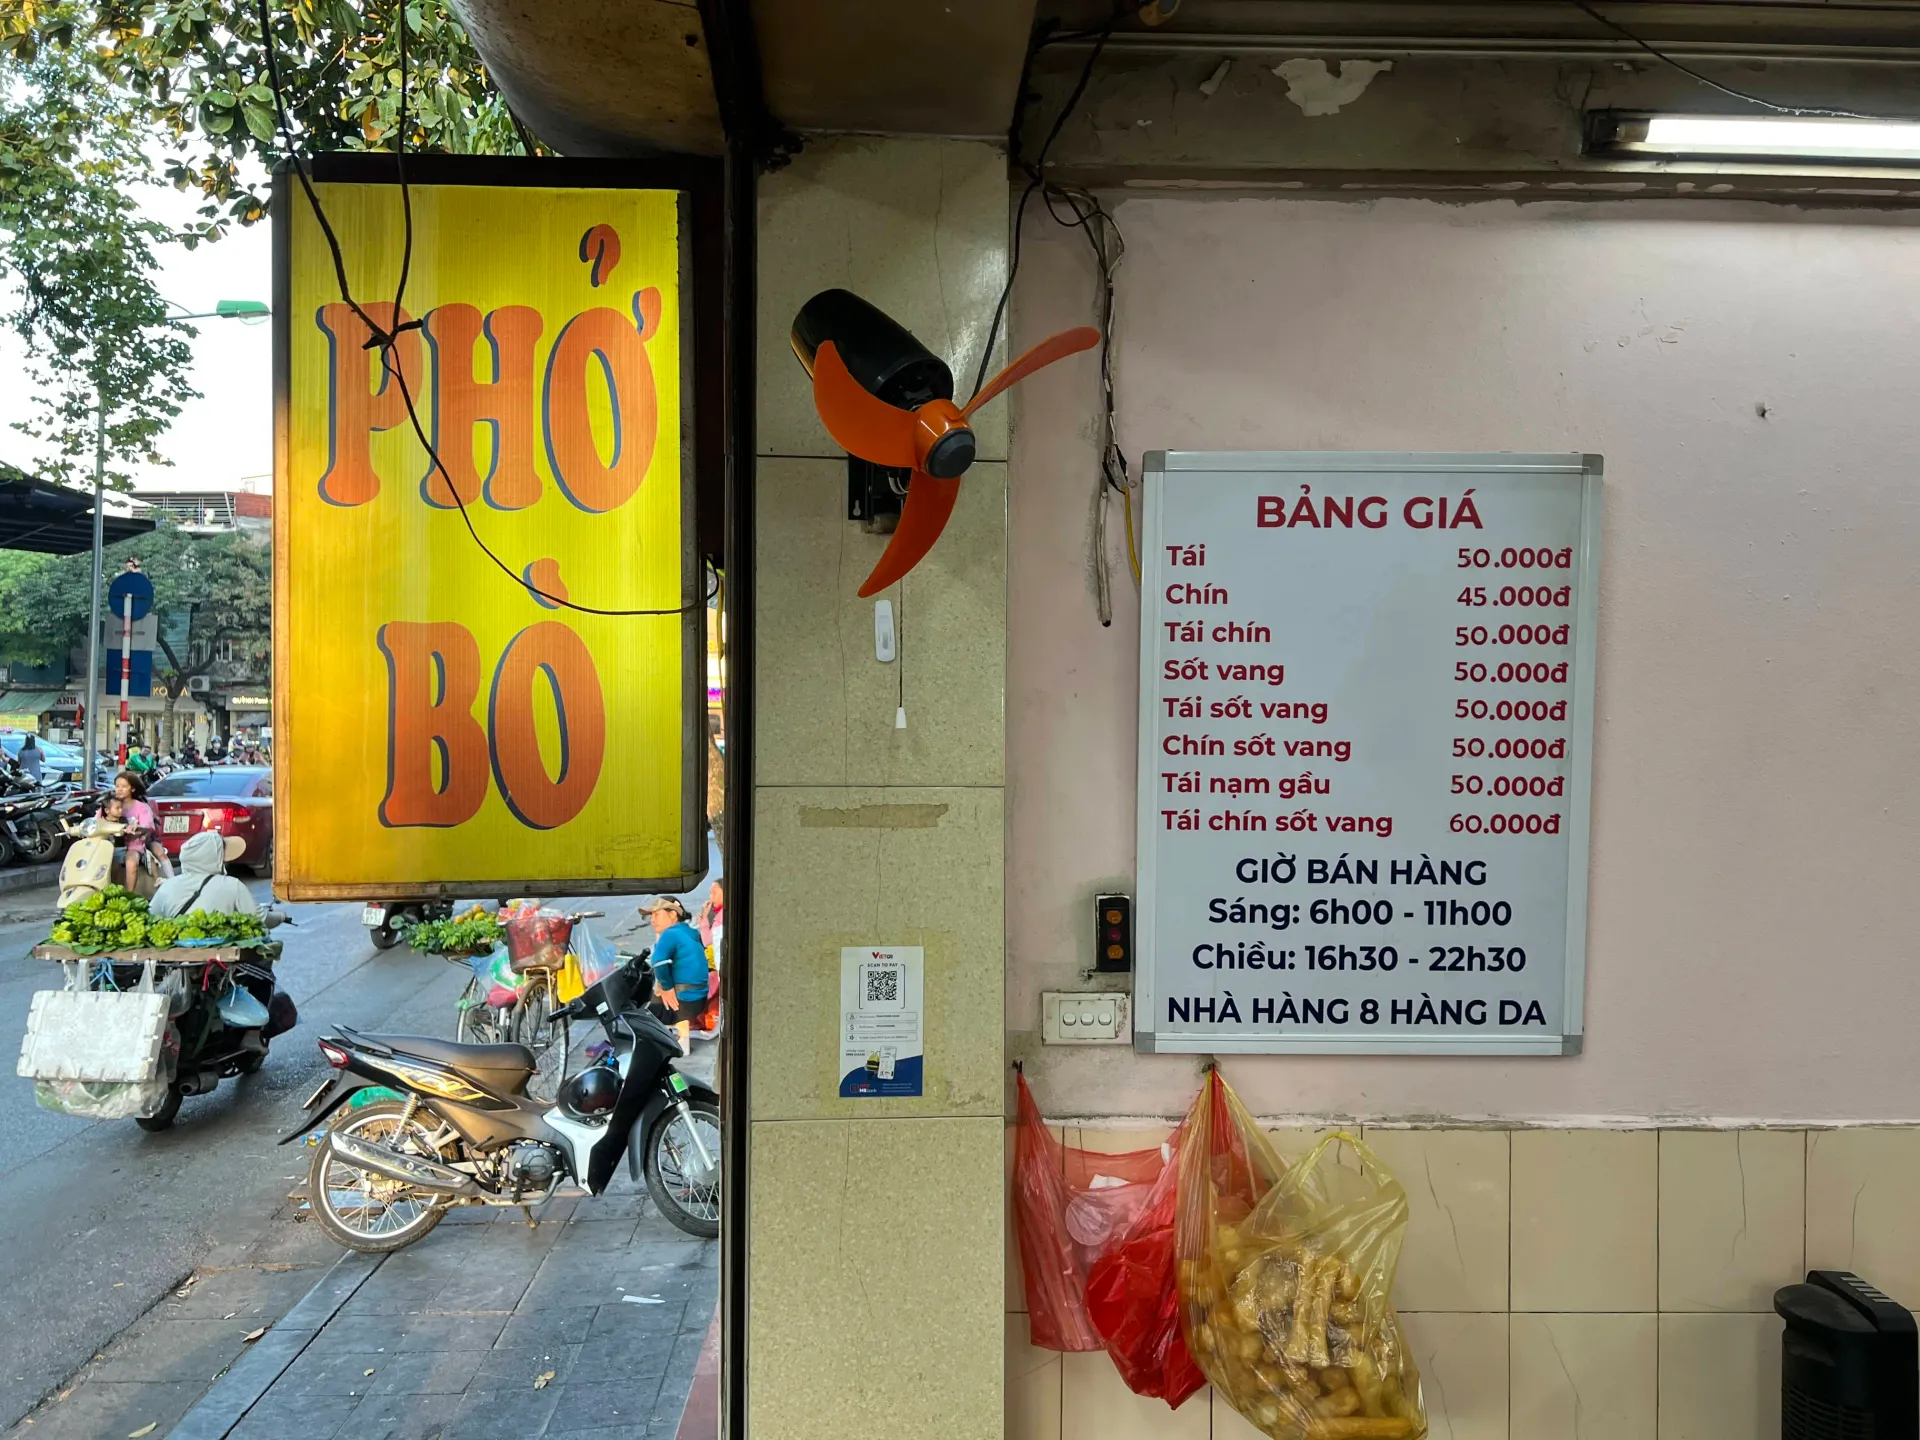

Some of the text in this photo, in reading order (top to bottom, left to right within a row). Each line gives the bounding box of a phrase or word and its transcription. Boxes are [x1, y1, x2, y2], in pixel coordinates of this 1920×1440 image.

[316, 224, 662, 514] PHỞ
[1257, 485, 1483, 529] BẢNG GIÁ
[1166, 545, 1572, 568] Tái 50.000đ
[1166, 583, 1571, 606] Chín 45.000đ
[1165, 621, 1570, 646] Tái chín 50.000đ
[1164, 657, 1568, 685] Sốt vang 50.000đ
[377, 557, 605, 830] BÒ
[1163, 695, 1567, 724] Tái sốt vang 50.000đ
[1163, 733, 1566, 761] Chín sốt vang 50.000đ
[1162, 771, 1564, 799] Tái nạm gầu 50.000đ
[1161, 809, 1561, 837] Tái chín sốt vang 60.000đ
[1236, 852, 1486, 885] GIỜ BÁN HÀNG
[1209, 897, 1299, 930] Sáng:
[1310, 898, 1393, 925] 6h00
[1424, 900, 1511, 926] 11h00
[1193, 941, 1295, 969] Chiều:
[1305, 945, 1398, 971] 16h30
[1429, 946, 1526, 972] 22h30
[1169, 991, 1546, 1025] NHÀ HÀNG 8 HÀNG DA
